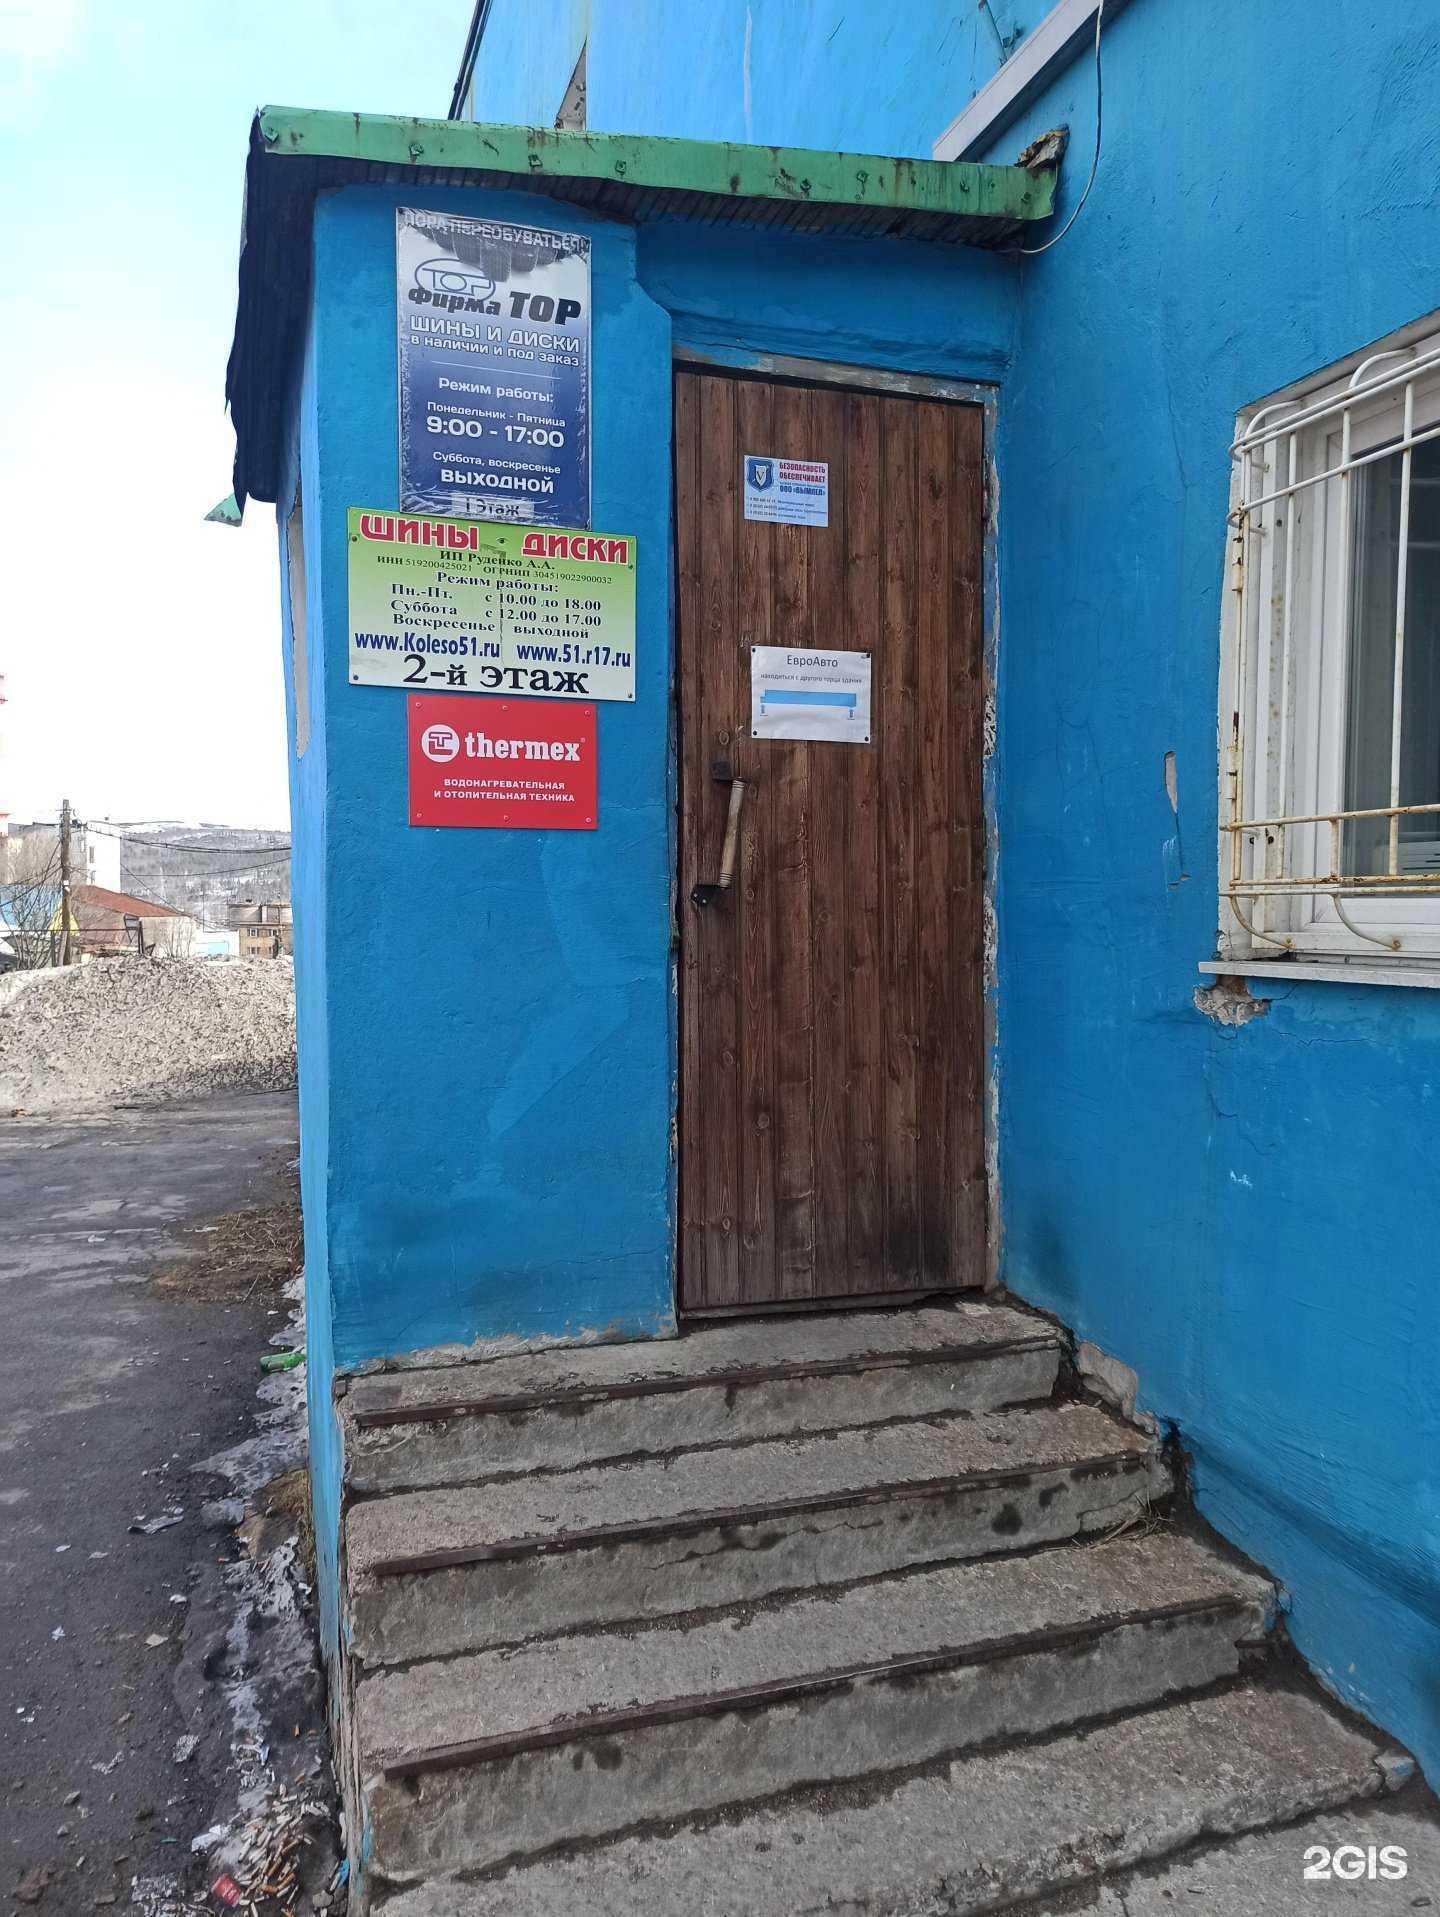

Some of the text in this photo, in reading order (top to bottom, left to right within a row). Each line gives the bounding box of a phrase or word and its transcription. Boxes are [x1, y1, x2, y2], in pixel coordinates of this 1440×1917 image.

[408, 288, 581, 325] Фирма ТОР
[410, 315, 579, 353] ШИНЫ И ДИСКИ
[411, 336, 579, 366] в наличии и под заказ
[438, 377, 553, 403] Режим работы:
[427, 402, 506, 419] Понедельник
[517, 413, 566, 427] Пятница
[426, 415, 483, 438] 9:00
[505, 425, 565, 448] 17:00
[433, 451, 561, 474] Суббота, воскресенье
[360, 514, 629, 564] ШИНЫ ДИСКИ
[377, 555, 403, 565] ИНН
[405, 558, 472, 571] 519200425021
[482, 566, 530, 577] ОГРНИП
[440, 550, 555, 570] ИП Руденко А.А.
[437, 572, 559, 593] Режим работы:
[391, 583, 601, 611] Пн.-Пт. с 10.00 до 18.00
[391, 599, 601, 626] Суббота с 12.00 до 17.00
[393, 614, 589, 639] Воскресенье выходной
[355, 632, 631, 668] www.Koleso51.ru www.51.r17.ru
[787, 654, 838, 667] ЕвроАвто
[403, 654, 589, 694] 2-й этаж
[465, 732, 581, 762] thermex
[433, 790, 575, 802] И ОТОПИТЕЛЬНАЯ ТЕХНИКА
[444, 779, 565, 790] ВОДОНАГРЕВАТЕЛЬНАЯ
